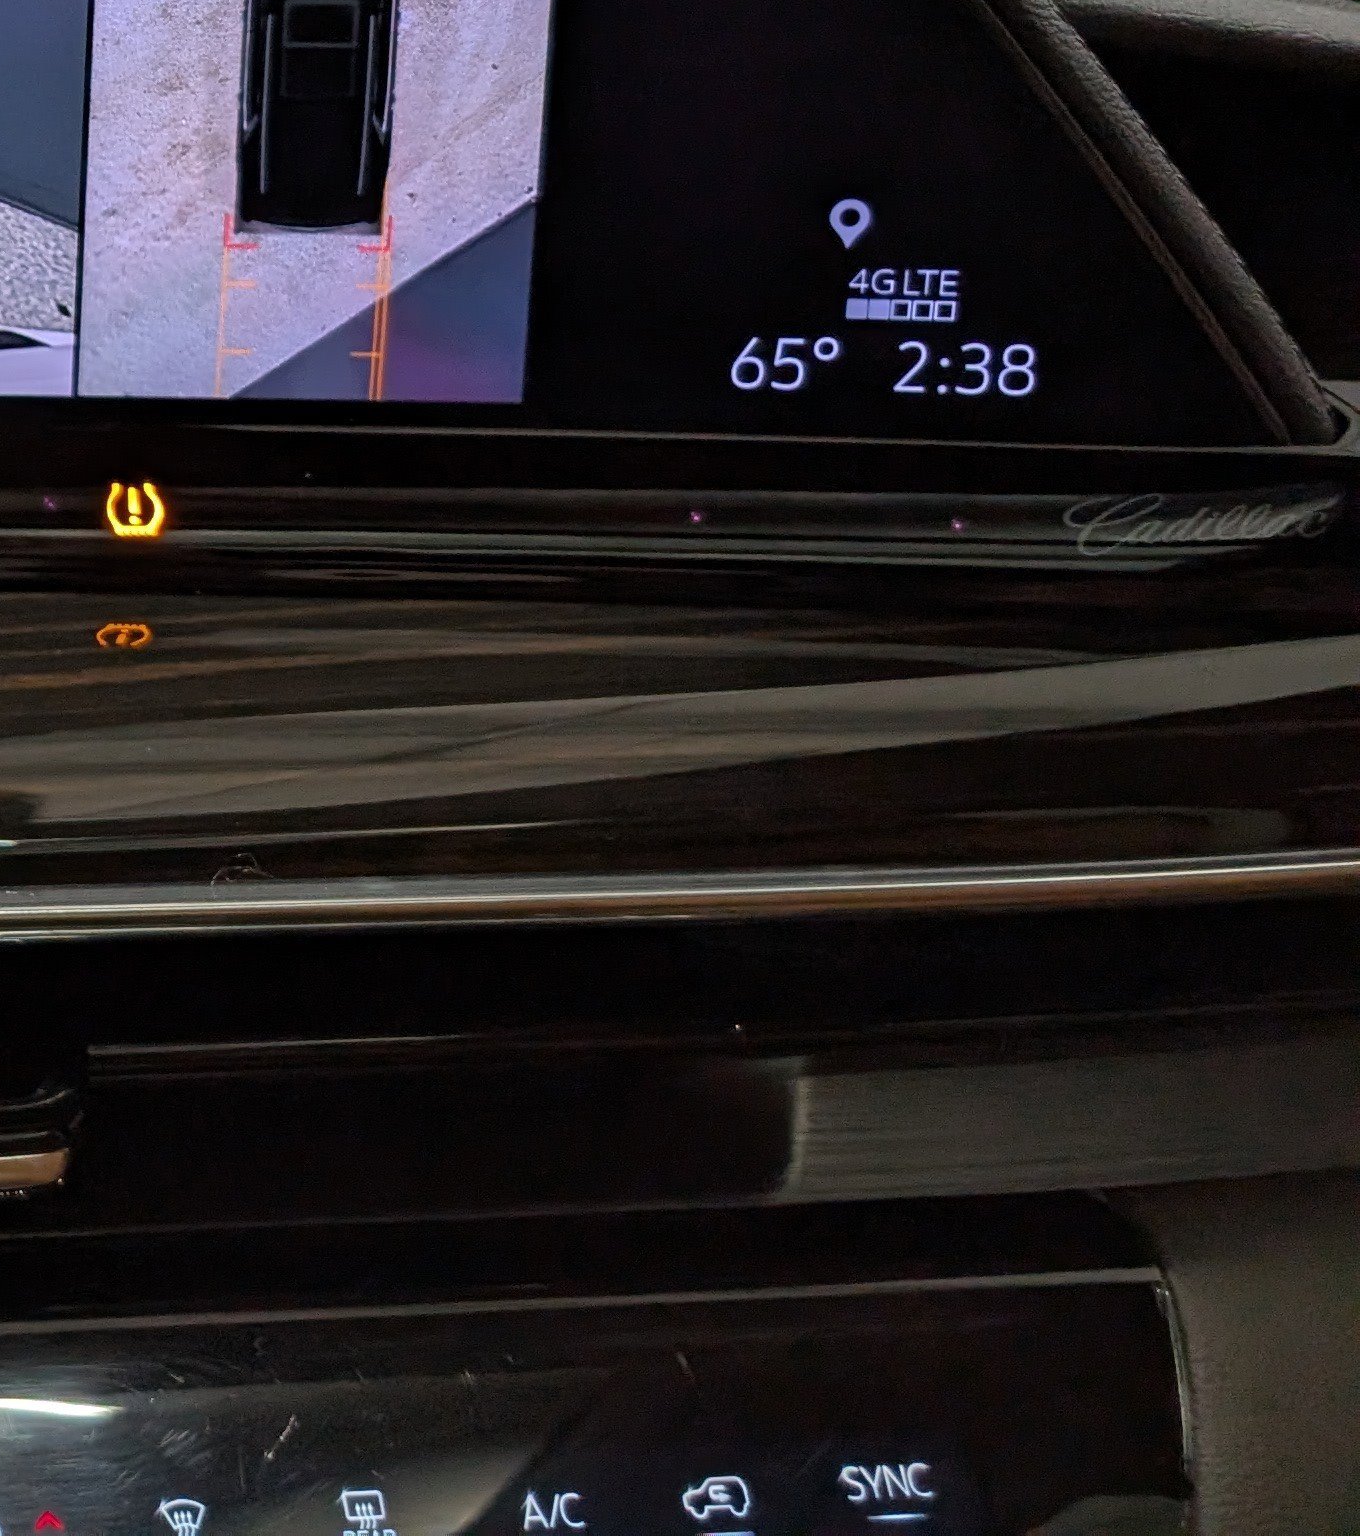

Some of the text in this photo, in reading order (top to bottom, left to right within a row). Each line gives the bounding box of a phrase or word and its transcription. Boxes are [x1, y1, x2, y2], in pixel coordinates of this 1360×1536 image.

[730, 336, 1036, 396] 65° 2:38
[838, 1462, 935, 1503] SYNC
[522, 1491, 586, 1530] A/C
